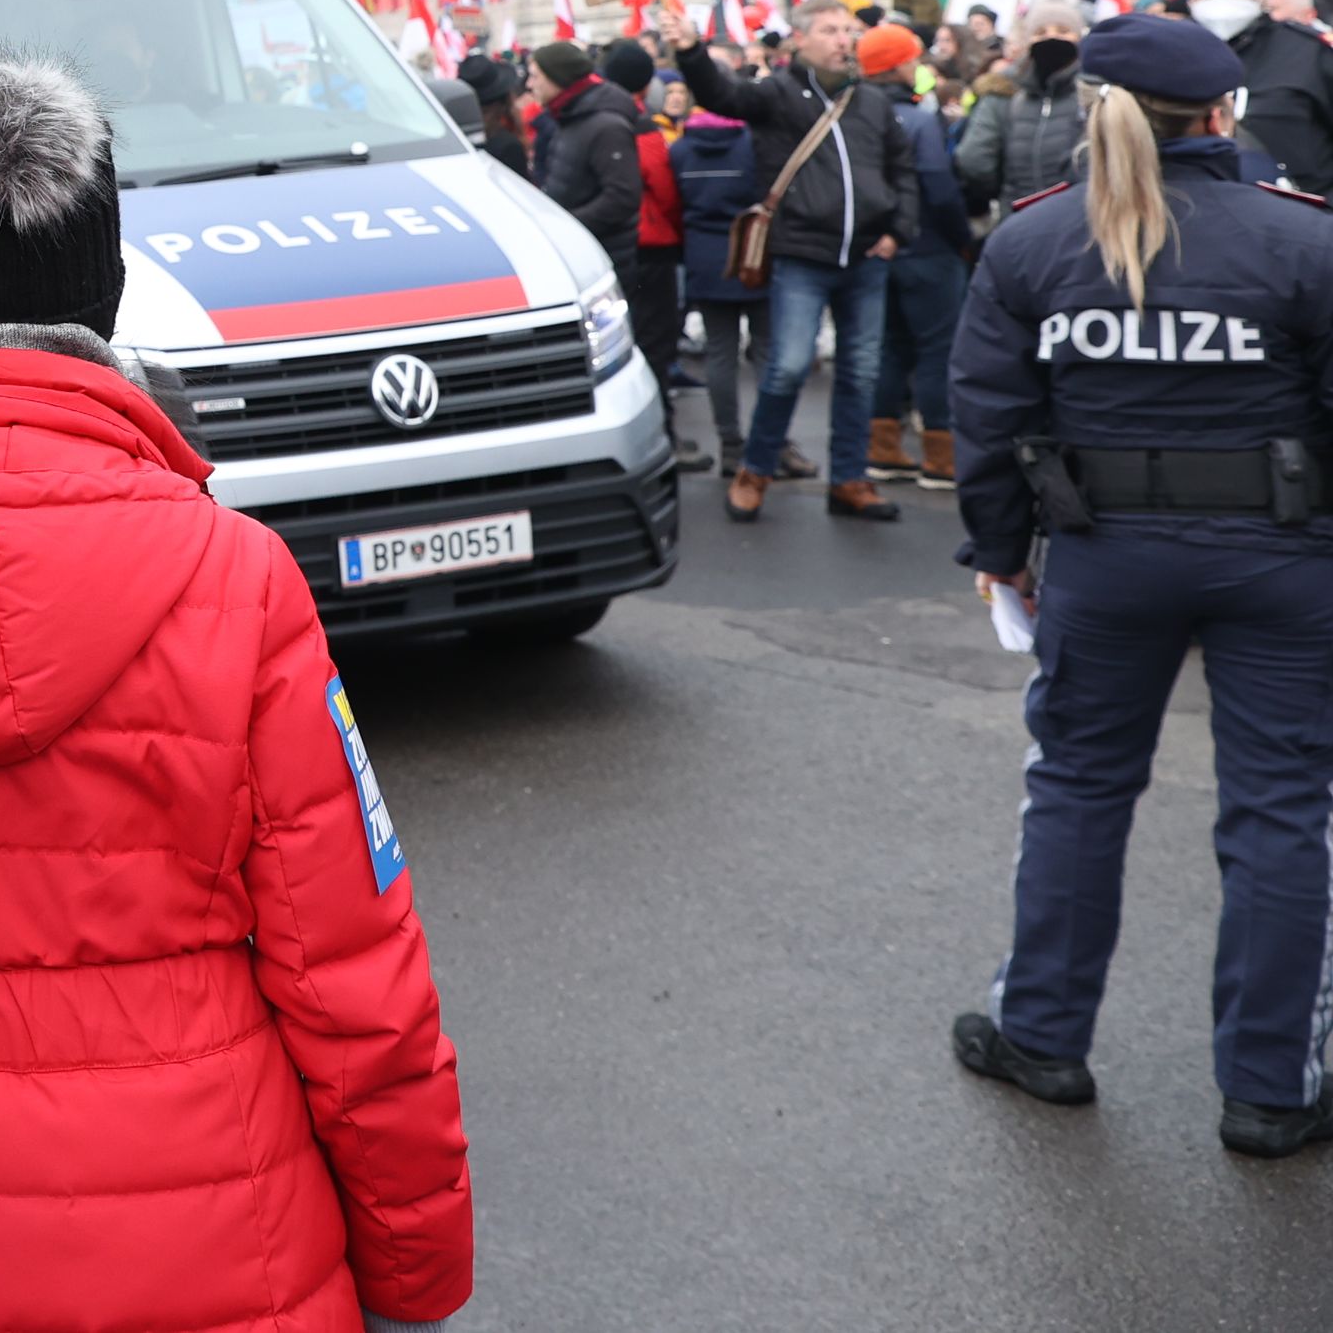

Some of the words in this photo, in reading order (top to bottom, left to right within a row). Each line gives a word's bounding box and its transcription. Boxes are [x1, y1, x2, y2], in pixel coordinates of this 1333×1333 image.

[145, 205, 471, 264] POLIZEI
[373, 540, 406, 572] BP
[430, 524, 514, 564] 90551
